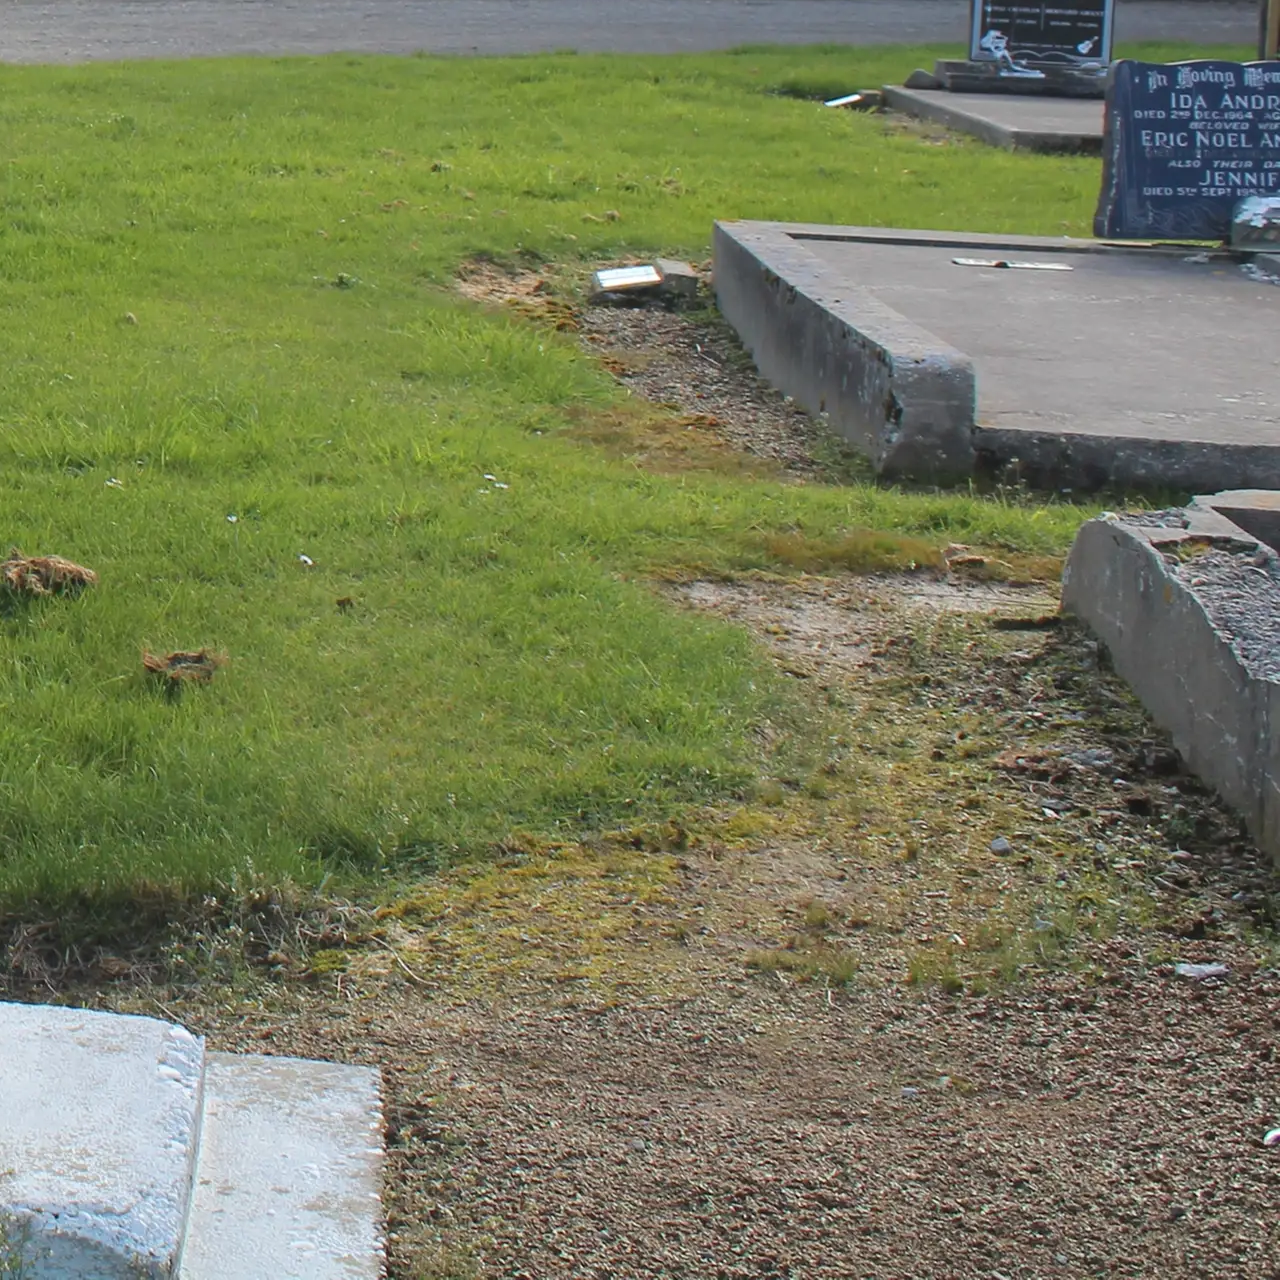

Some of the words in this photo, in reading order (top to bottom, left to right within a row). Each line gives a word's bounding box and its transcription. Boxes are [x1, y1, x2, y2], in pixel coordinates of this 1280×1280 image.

[1147, 70, 1168, 93] In
[1175, 66, 1236, 90] Loving
[1171, 92, 1207, 109] IDA
[1134, 110, 1166, 119] DIED
[1188, 121, 1250, 130] BELOVED
[1141, 130, 1189, 148] ERIC
[1195, 130, 1253, 148] NOEL
[1168, 159, 1202, 168] ALSO
[1212, 160, 1253, 169] THEIR
[1198, 170, 1279, 187] JENNIF
[1143, 187, 1173, 196] DIED
